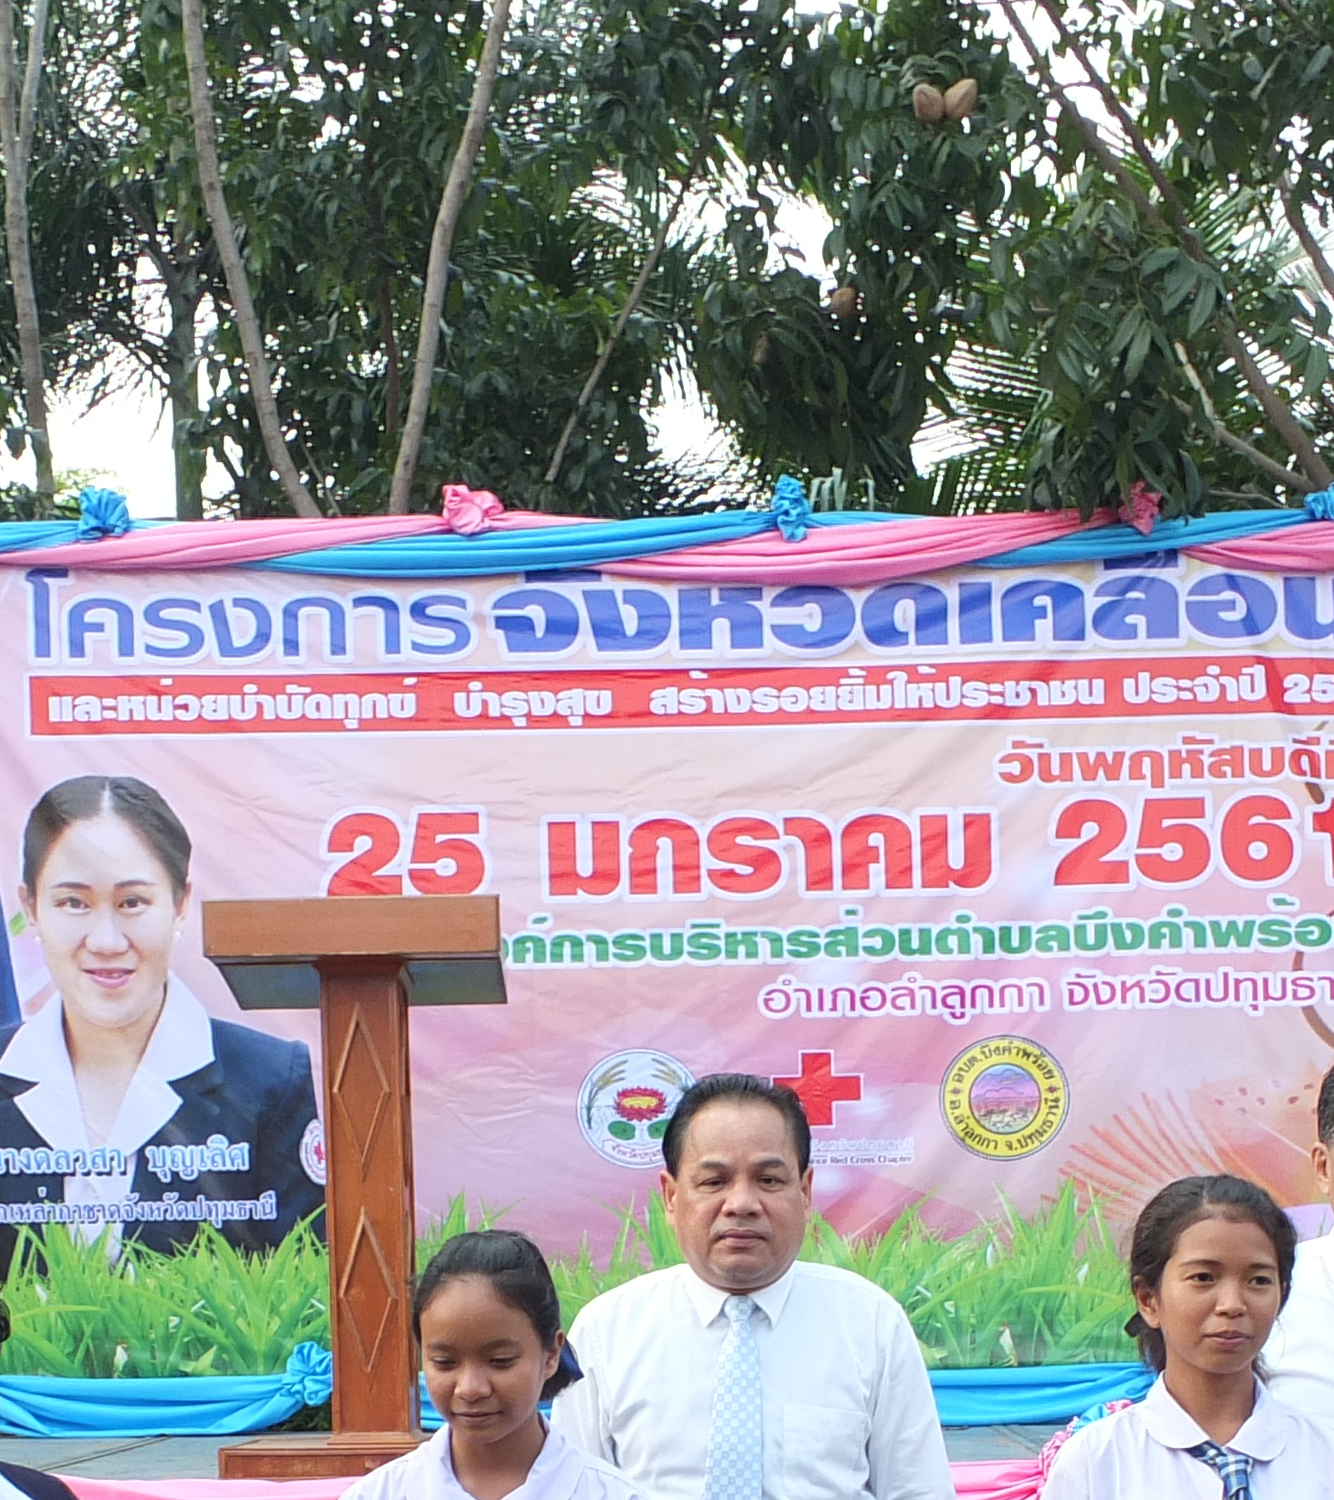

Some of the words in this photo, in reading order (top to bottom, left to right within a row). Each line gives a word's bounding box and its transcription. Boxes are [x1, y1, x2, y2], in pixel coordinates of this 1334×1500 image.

[47, 677, 418, 729] และหน่วยบำบัดทุกข์
[453, 680, 613, 727] บำรุงสุข
[648, 665, 1105, 716] สร้างรอยยิ้มให้ประชาชน
[1122, 664, 1267, 705] ประจำปี
[327, 811, 486, 897] 25
[546, 811, 993, 897] มกราคม
[762, 976, 1045, 1020] อำเภอลำลูกกา
[145, 1133, 250, 1182] บุญเลิศ
